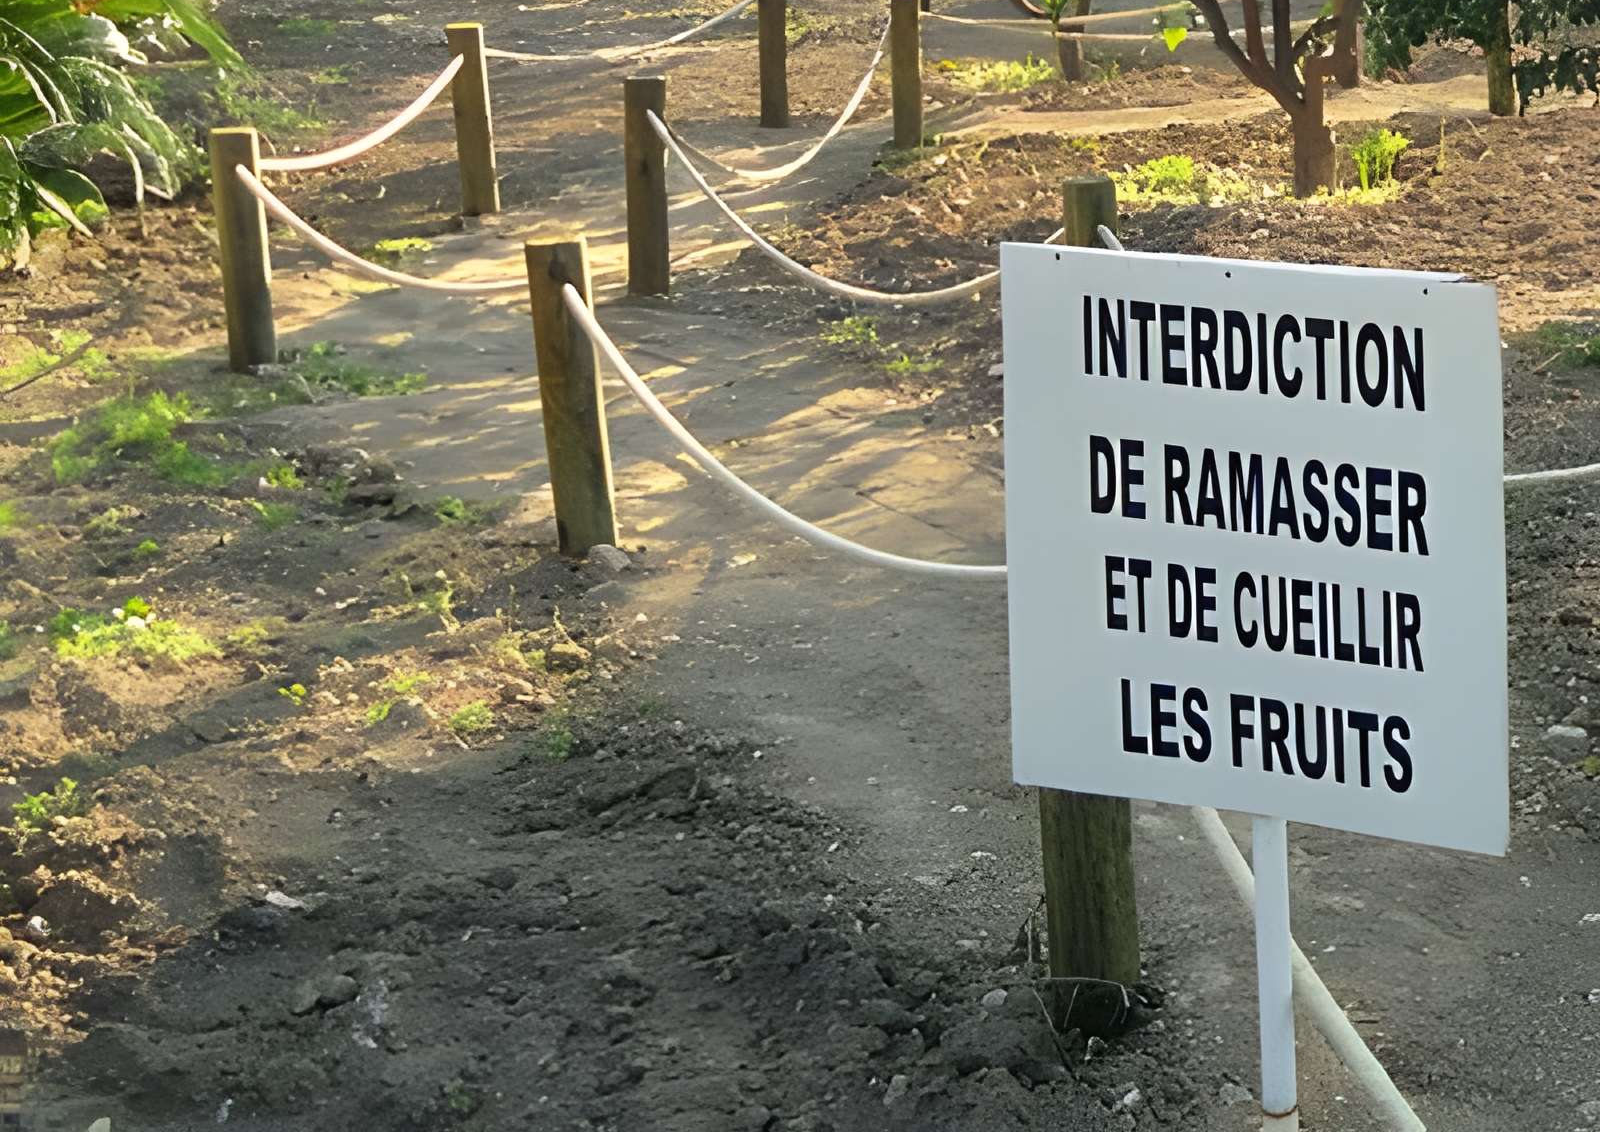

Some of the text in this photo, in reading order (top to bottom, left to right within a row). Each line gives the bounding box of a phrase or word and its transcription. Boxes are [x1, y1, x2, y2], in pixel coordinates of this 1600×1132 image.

[1083, 295, 1426, 412] INTERDICTION
[1089, 434, 1430, 557] DE RAMASSER
[1104, 555, 1425, 673] ET DE CUEILLIR
[1120, 678, 1413, 794] LES FRUITS
